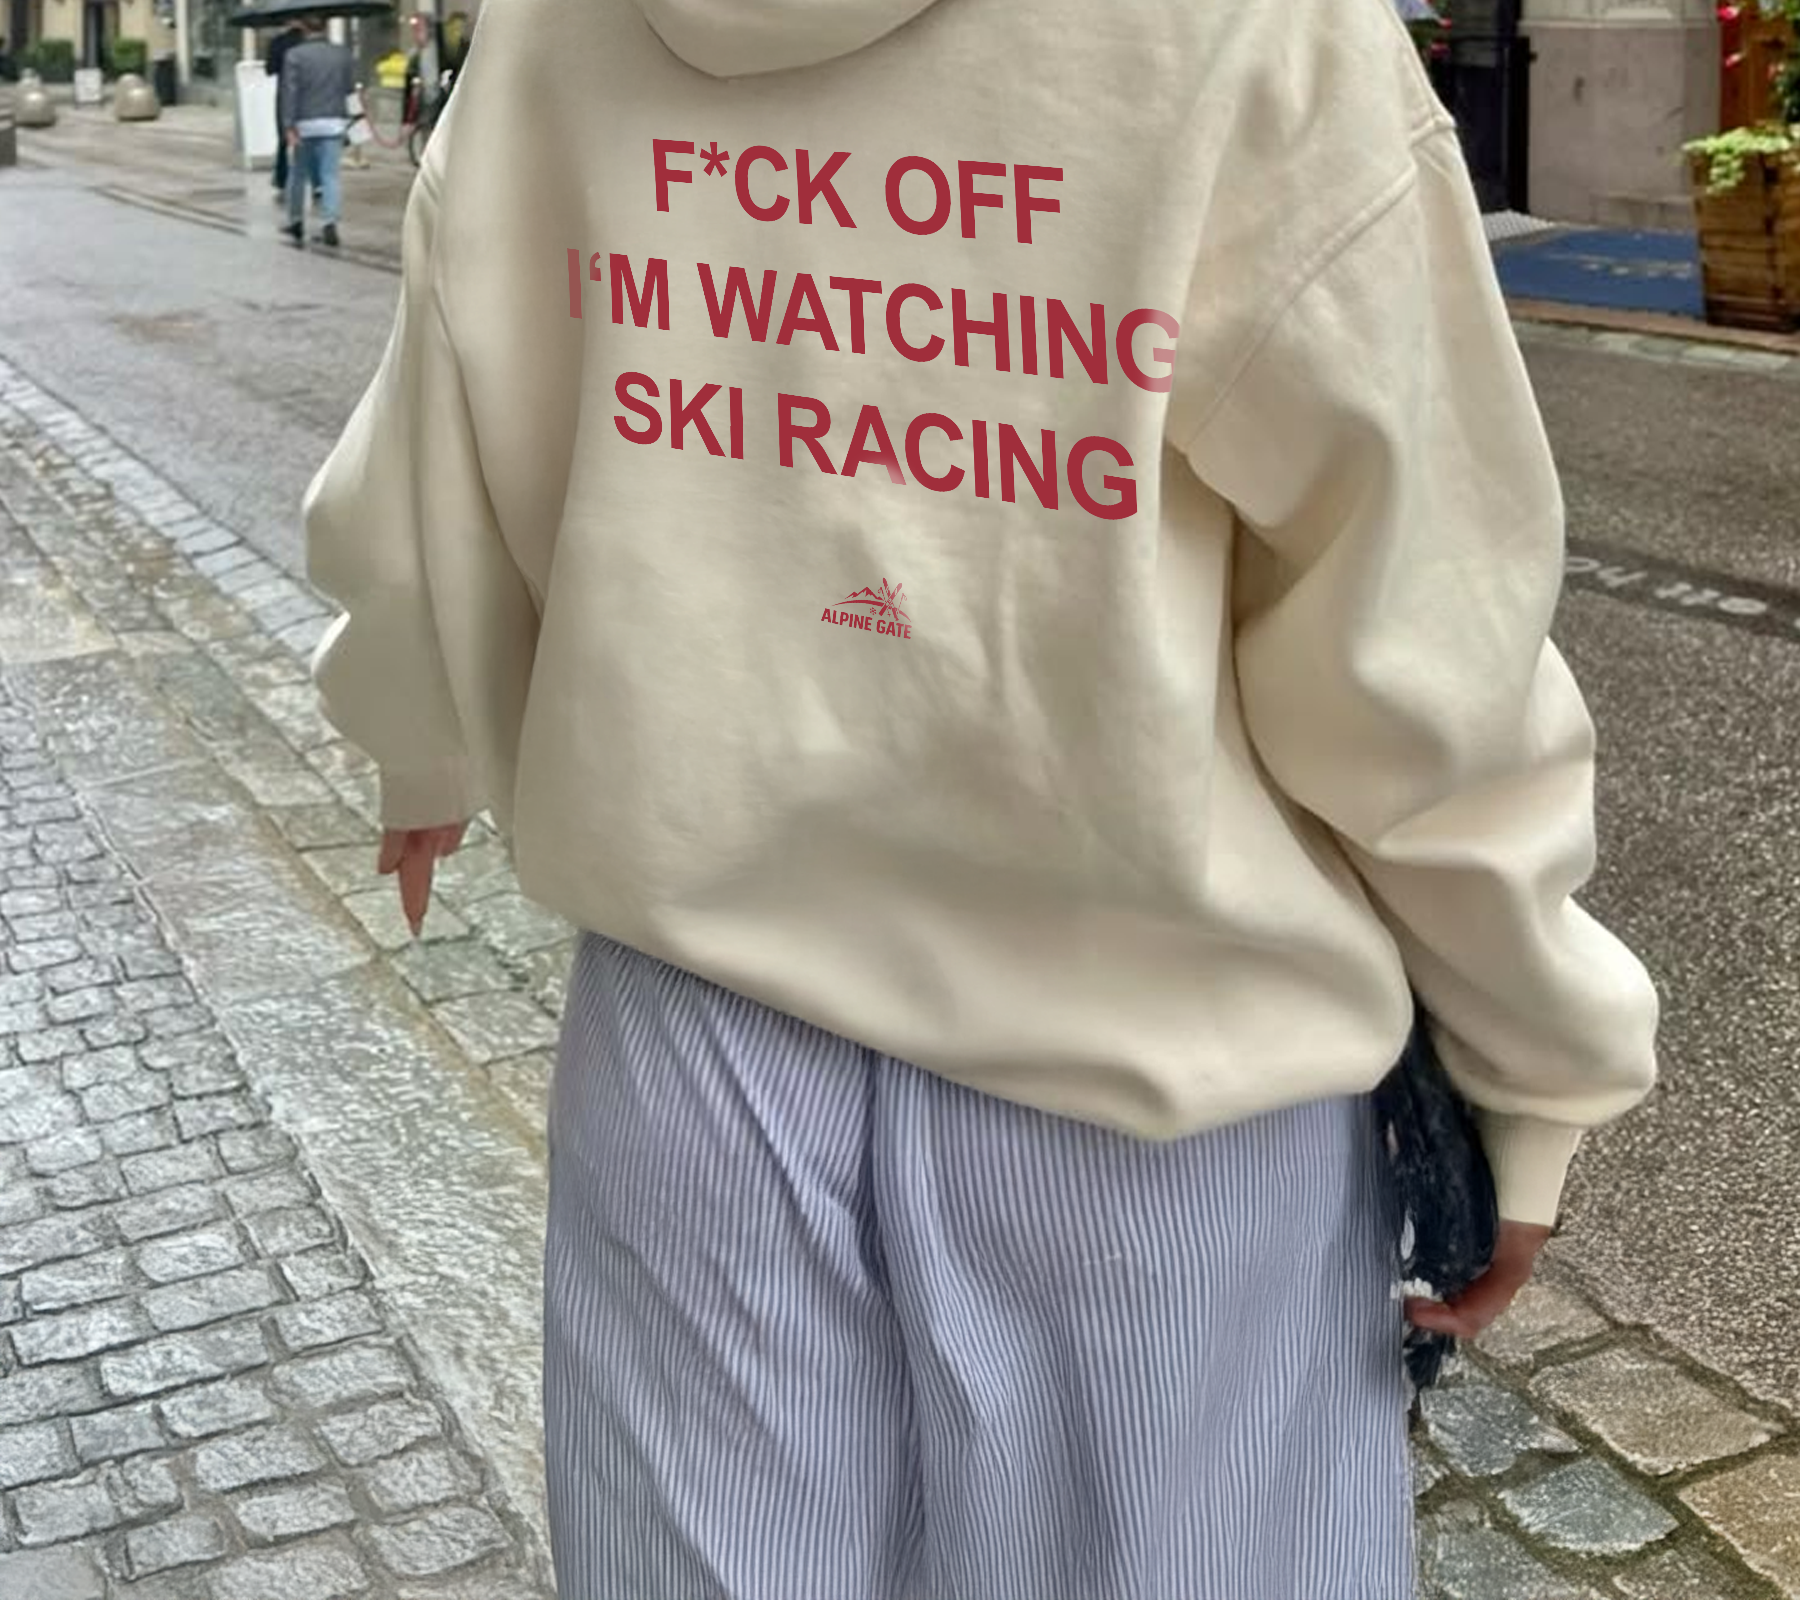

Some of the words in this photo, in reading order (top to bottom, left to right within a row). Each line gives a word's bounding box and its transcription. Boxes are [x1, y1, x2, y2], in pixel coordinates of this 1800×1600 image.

[885, 156, 1063, 244] OFF
[697, 263, 1180, 393] WATCHING
[614, 372, 744, 460] SKI
[778, 393, 1137, 520] RACING
[821, 608, 873, 631] ALPINE
[876, 620, 912, 639] GATE
